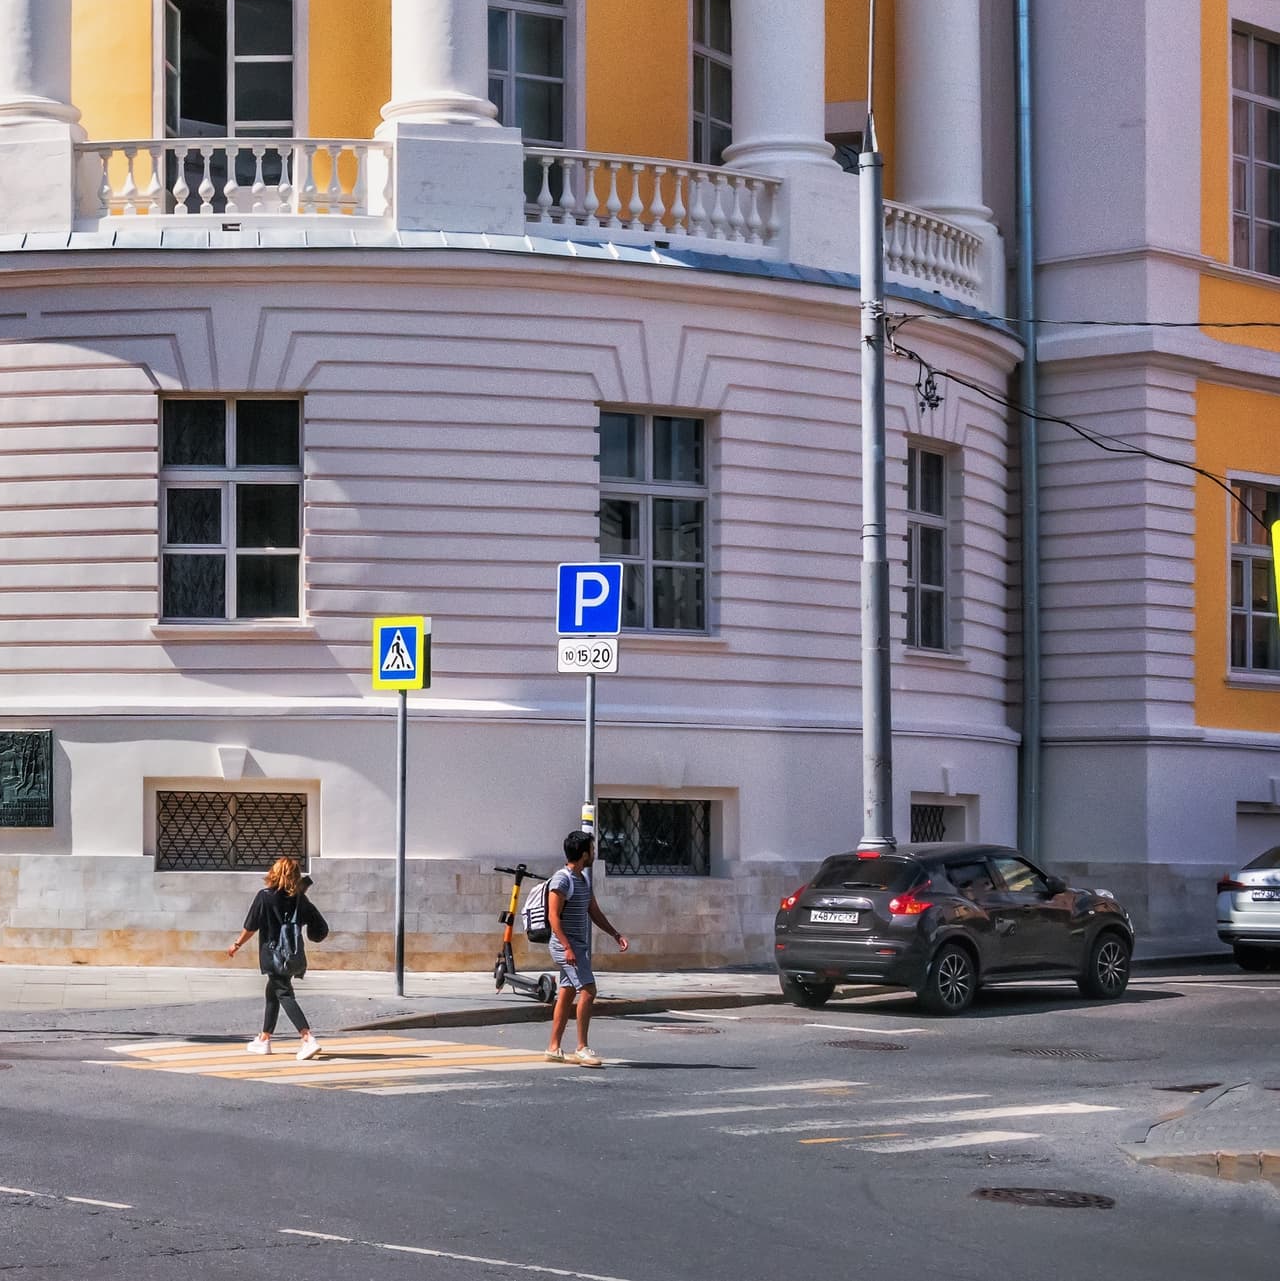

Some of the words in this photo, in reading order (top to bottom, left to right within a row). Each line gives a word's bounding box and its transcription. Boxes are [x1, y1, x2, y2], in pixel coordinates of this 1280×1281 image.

[575, 571, 610, 627] P
[565, 651, 574, 661] 10
[577, 649, 588, 662] 15
[592, 648, 610, 663] 20
